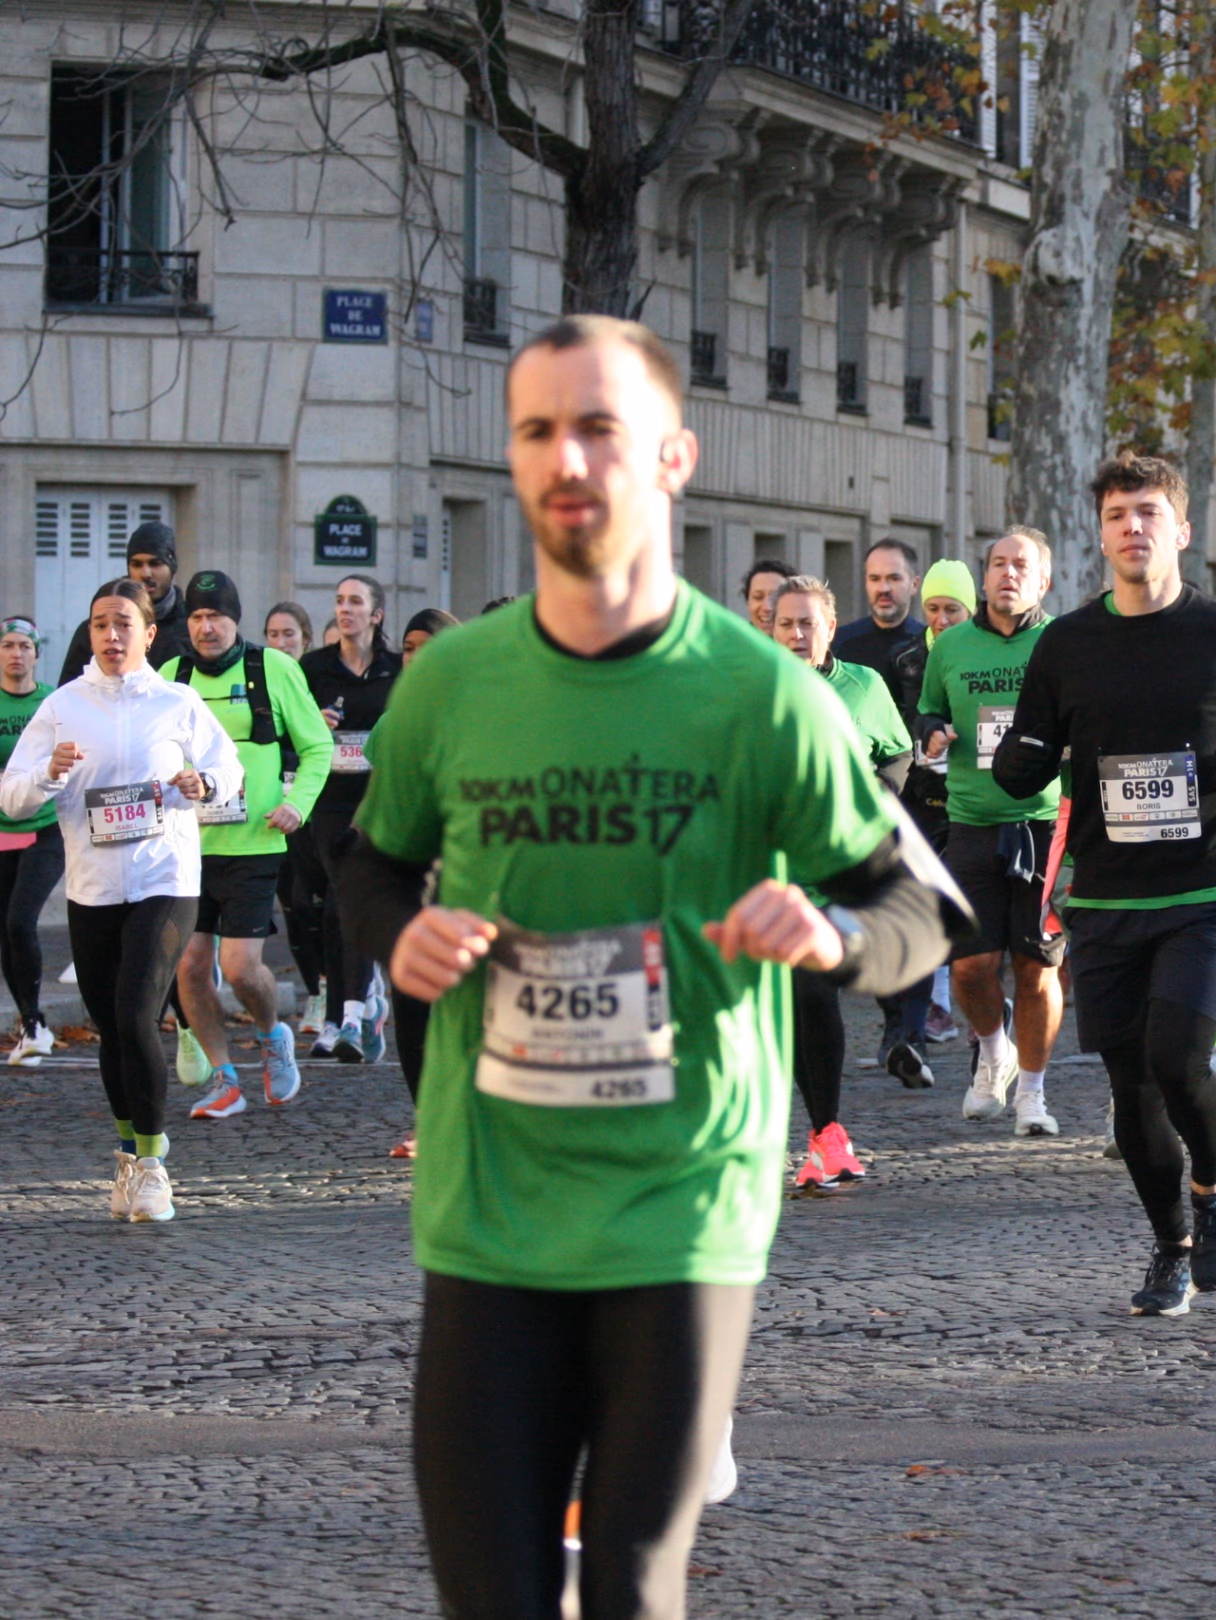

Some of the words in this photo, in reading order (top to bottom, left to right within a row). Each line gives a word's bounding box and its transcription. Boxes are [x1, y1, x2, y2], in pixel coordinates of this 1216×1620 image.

[337, 296, 373, 308] PLACE
[330, 323, 381, 336] WAGRAM
[329, 523, 362, 536] PLACE
[323, 545, 368, 557] WAGRAM
[959, 670, 991, 681] 10KM
[340, 746, 363, 758] 536
[1137, 757, 1174, 769] ONATERA
[540, 753, 722, 803] ONATERA
[1124, 767, 1157, 778] PARIS
[1157, 766, 1168, 777] 17
[1122, 779, 1174, 800] 6599
[1188, 786, 1196, 802] SAS
[104, 795, 131, 805] PARIS
[1136, 802, 1161, 810] BORIS
[104, 803, 146, 824] 5184
[480, 804, 639, 847] PARIS
[643, 804, 695, 856] 17
[1160, 827, 1189, 838] 6599
[516, 981, 620, 1021] 4265
[590, 1079, 648, 1099] 4265
